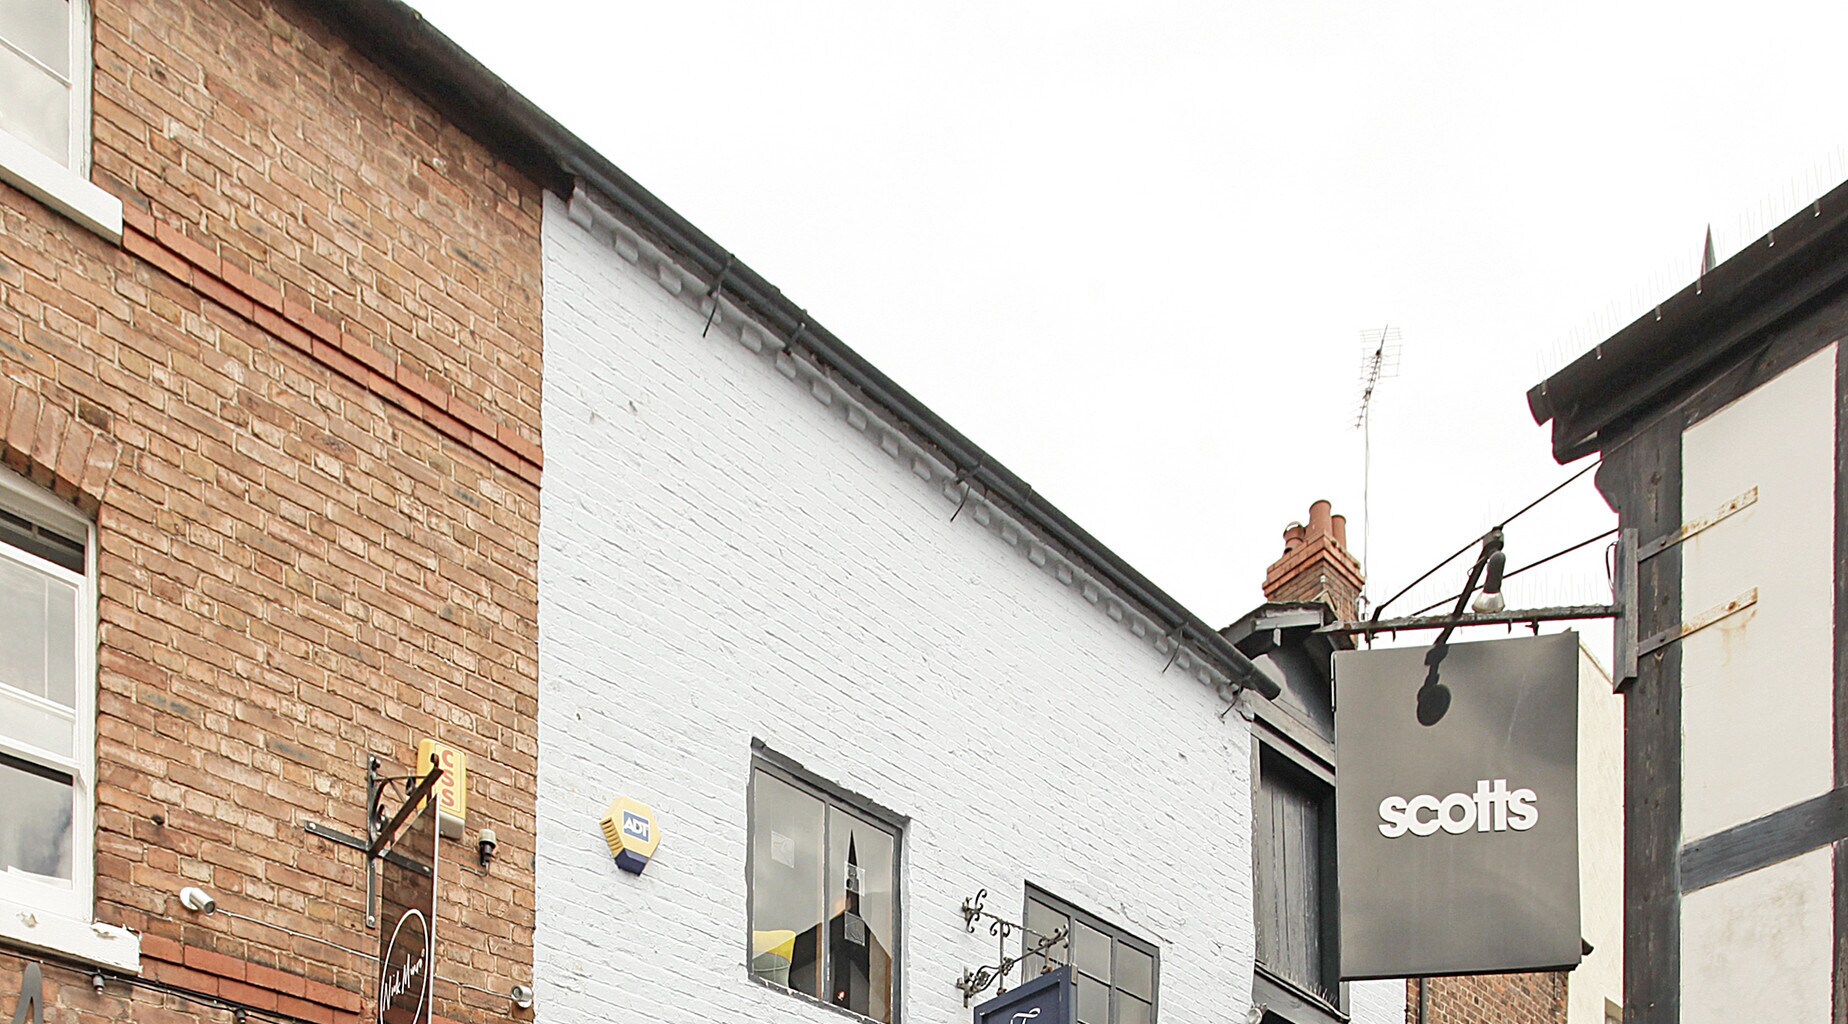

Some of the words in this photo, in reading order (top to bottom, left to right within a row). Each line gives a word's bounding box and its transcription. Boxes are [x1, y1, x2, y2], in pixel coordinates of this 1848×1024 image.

[441, 749, 455, 807] CSS
[623, 816, 649, 837] ADT
[1378, 779, 1539, 839] scotts
